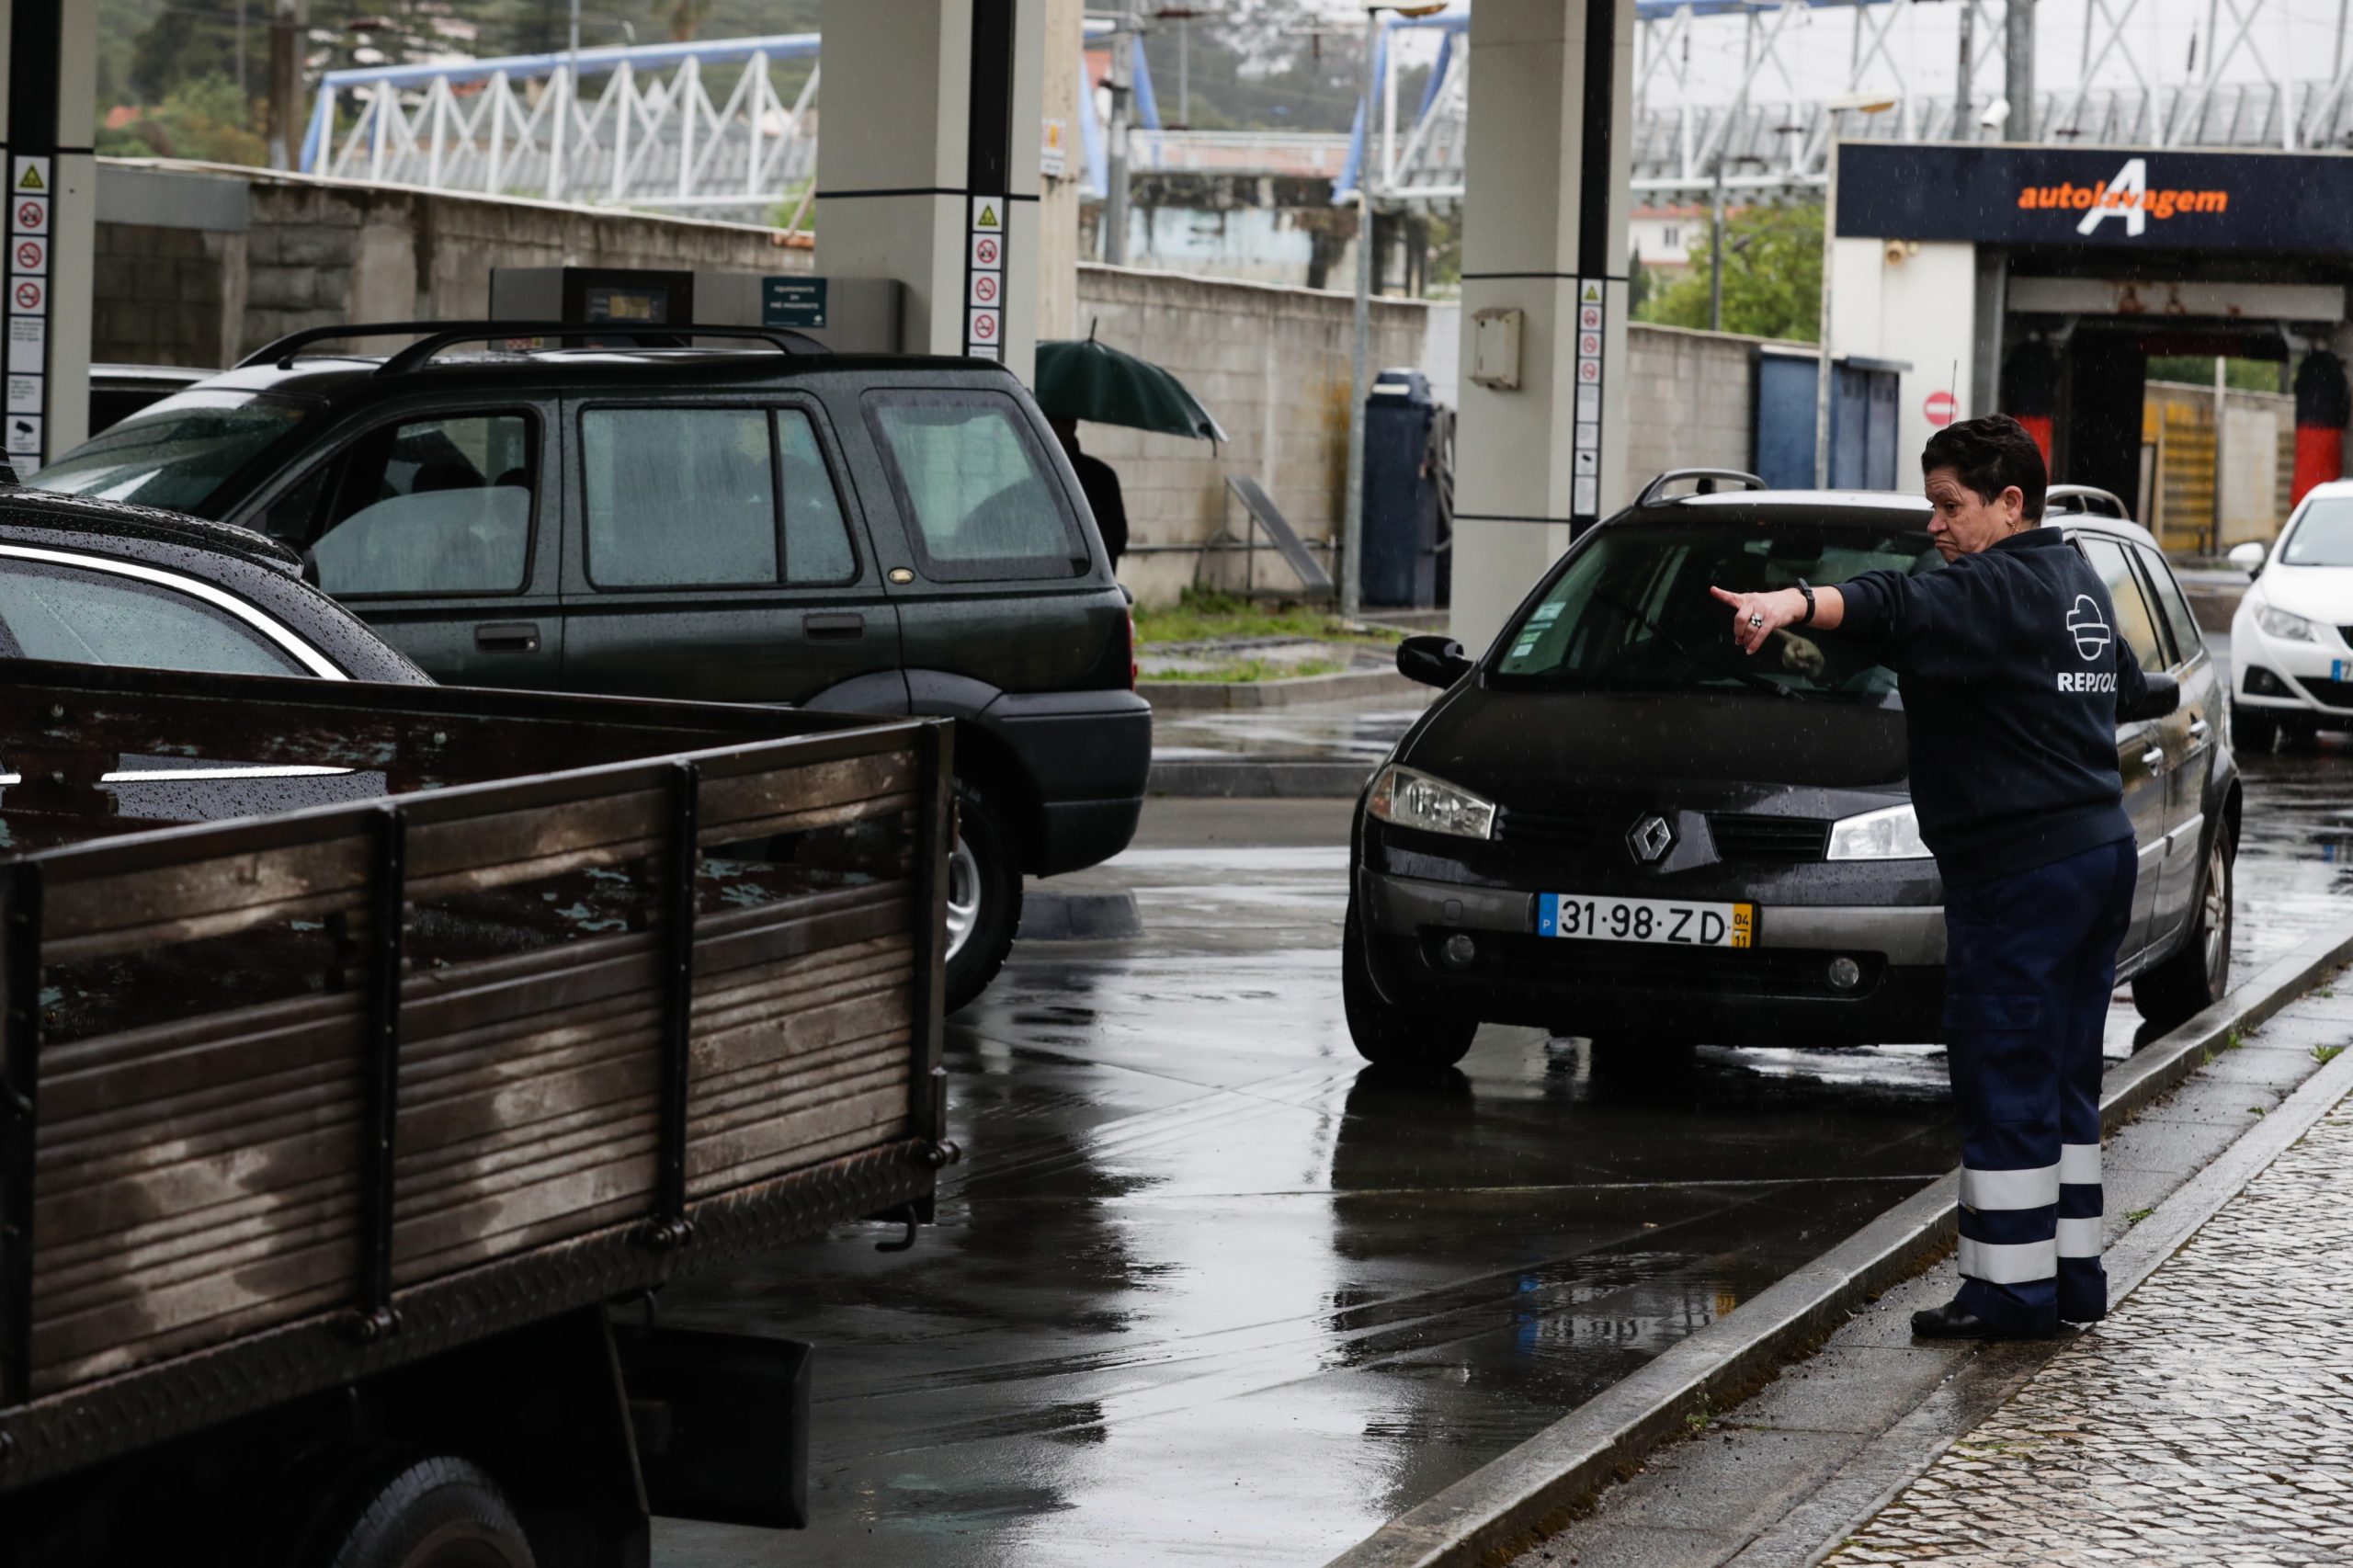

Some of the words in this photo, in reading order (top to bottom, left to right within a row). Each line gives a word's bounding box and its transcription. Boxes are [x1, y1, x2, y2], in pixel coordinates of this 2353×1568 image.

[2018, 180, 2229, 219] autolavagem
[2057, 672, 2117, 693] REPSOL
[1542, 919, 1551, 929] P
[1734, 913, 1749, 926] 04
[1734, 935, 1748, 948] 11
